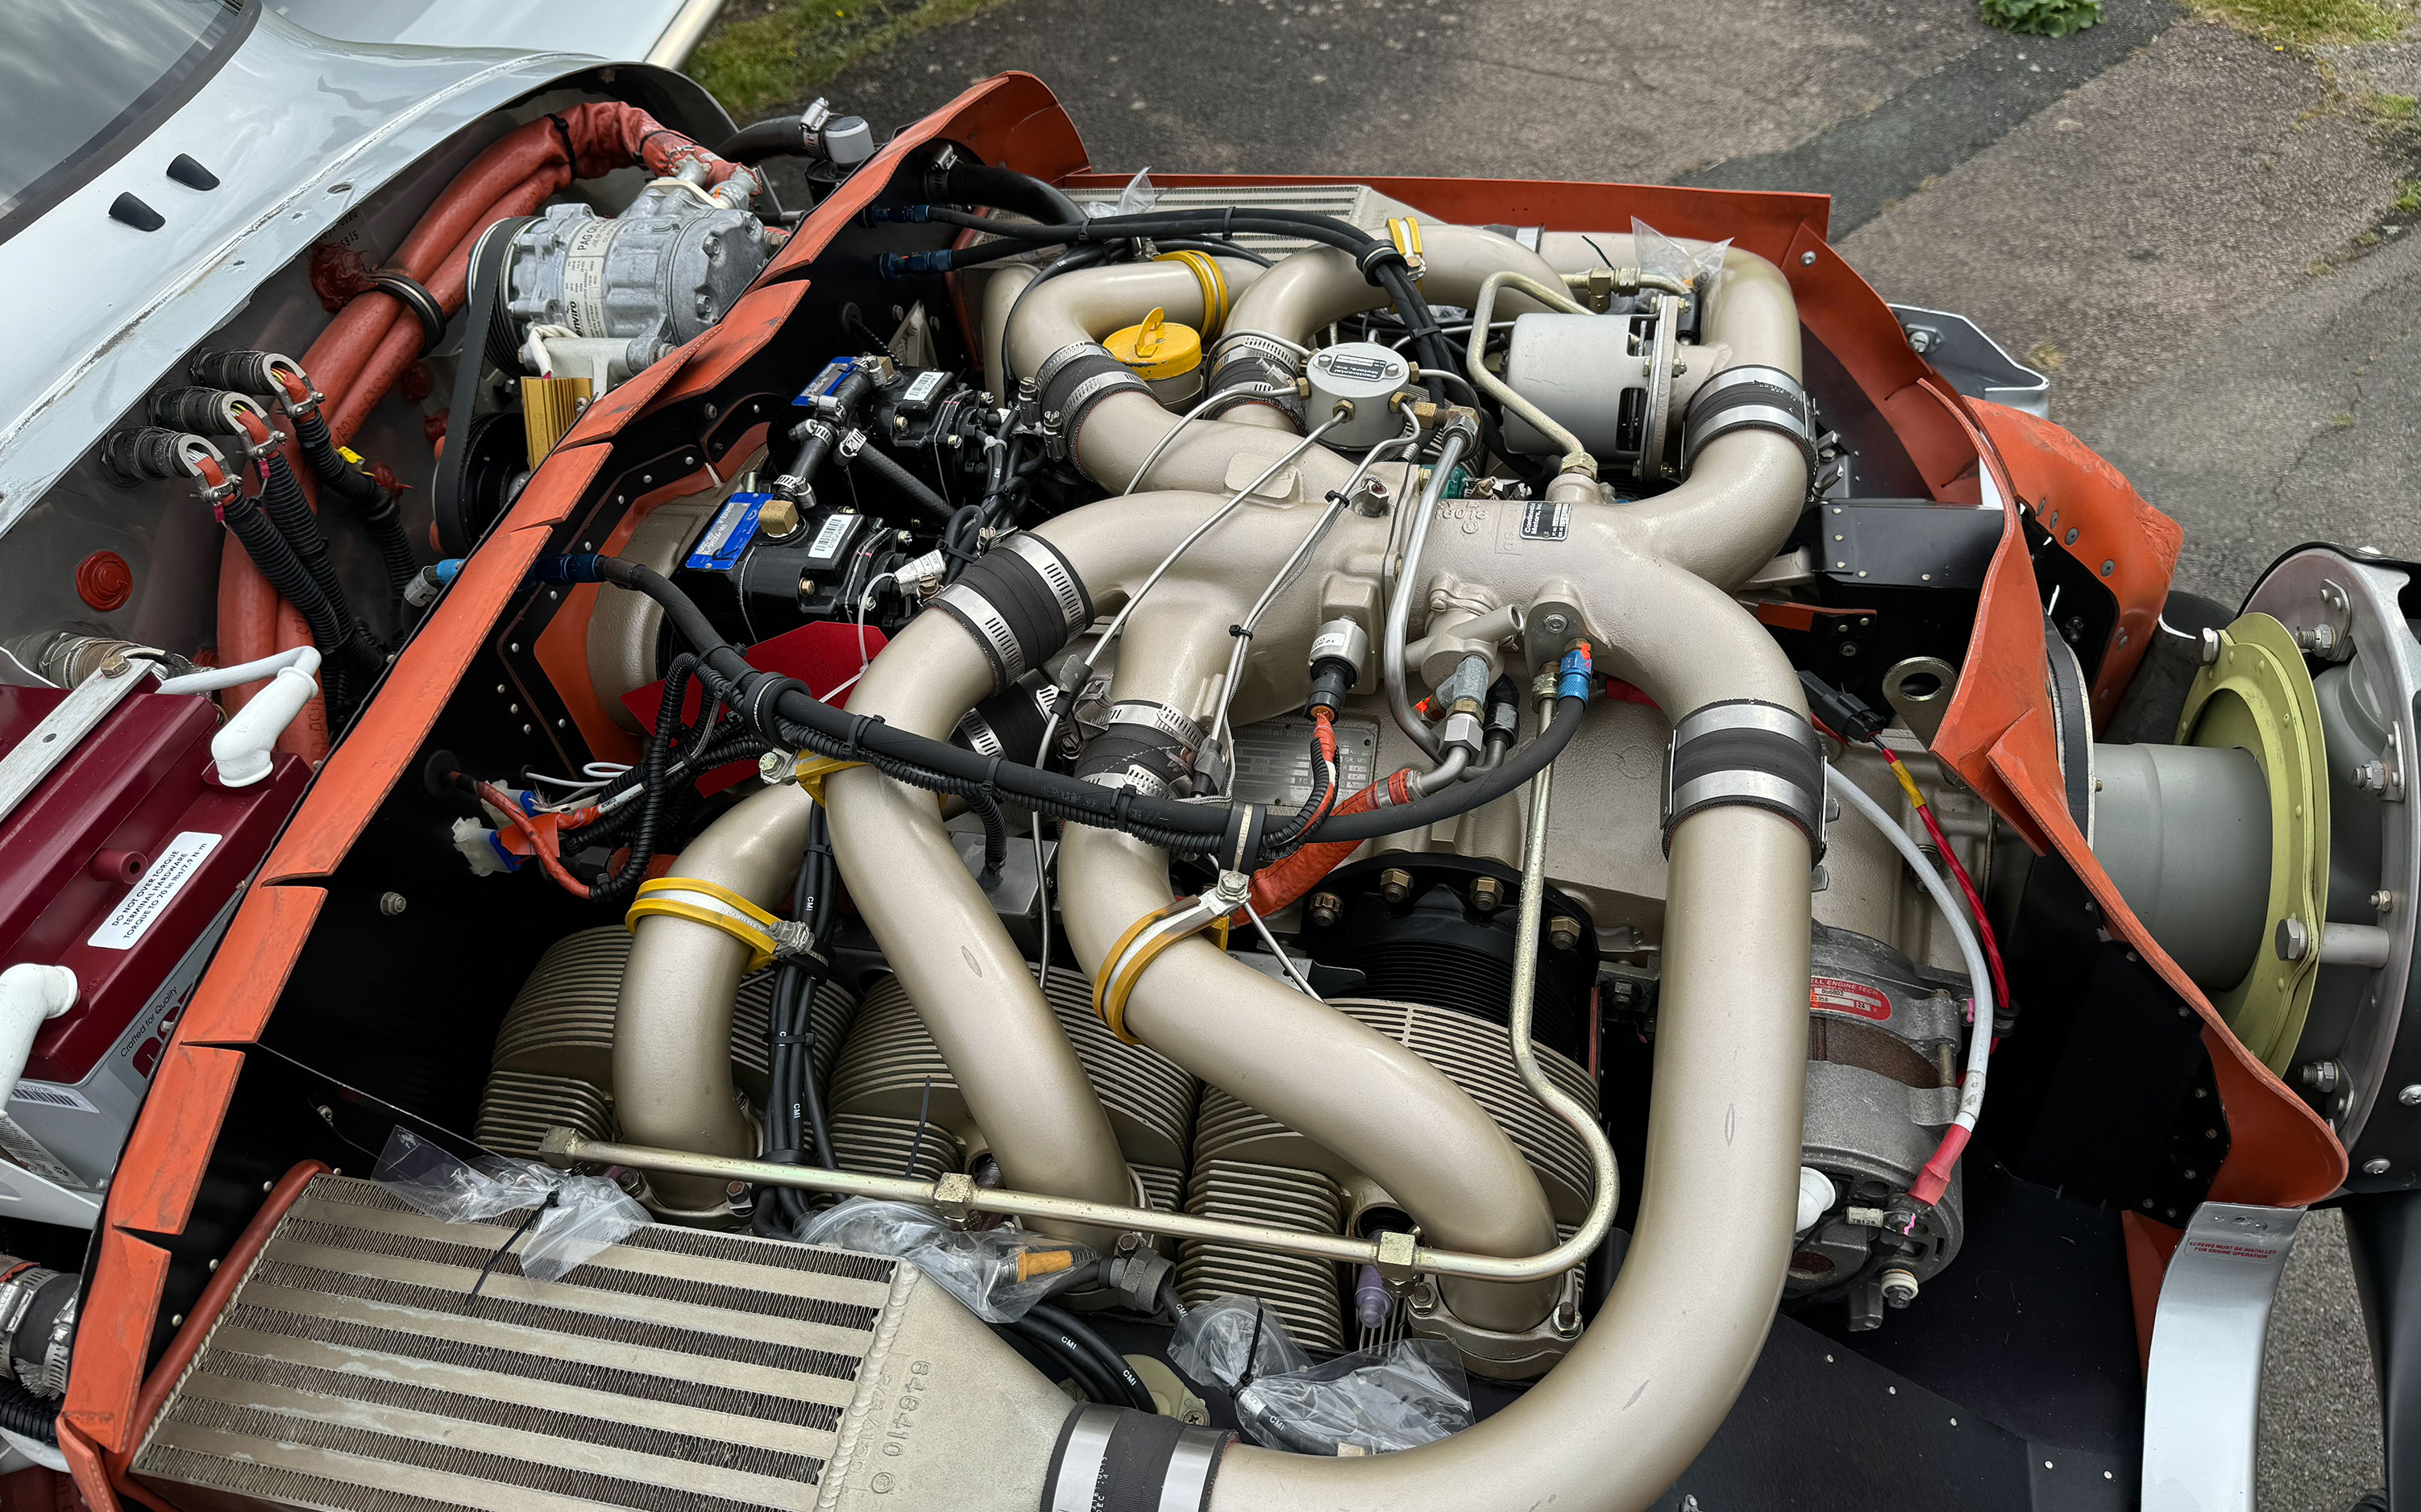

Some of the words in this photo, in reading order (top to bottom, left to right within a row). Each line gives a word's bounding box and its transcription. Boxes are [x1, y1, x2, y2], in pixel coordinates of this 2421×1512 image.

[577, 231, 592, 251] PAG
[567, 300, 583, 338] enviro
[1334, 368, 1377, 379] Continental
[994, 467, 1002, 479] CMI
[111, 914, 125, 927] DO
[122, 898, 139, 914] NOT
[136, 877, 156, 898] OVER
[153, 850, 180, 879] TORQUE
[123, 891, 156, 926] TERMINAL
[153, 853, 189, 891] HARDWARE
[806, 895, 815, 912] CMI
[123, 910, 152, 940] TORQUE
[147, 899, 159, 912] TO
[156, 890, 168, 899] 70
[1826, 979, 1856, 991] ENGINE
[1858, 985, 1879, 996] TECH
[121, 1025, 147, 1057] Crafted
[145, 1014, 156, 1028] for
[155, 986, 178, 1015] Quality
[779, 1031, 787, 1047] CI
[793, 1102, 801, 1119] CMI
[2232, 1251, 2269, 1259] OPERATION
[2244, 1247, 2278, 1255] INSTALLED
[1175, 1302, 1189, 1319] CMI
[1061, 1335, 1078, 1351] CMI
[1123, 1369, 1137, 1387] CMI
[1269, 1415, 1285, 1431] CMI
